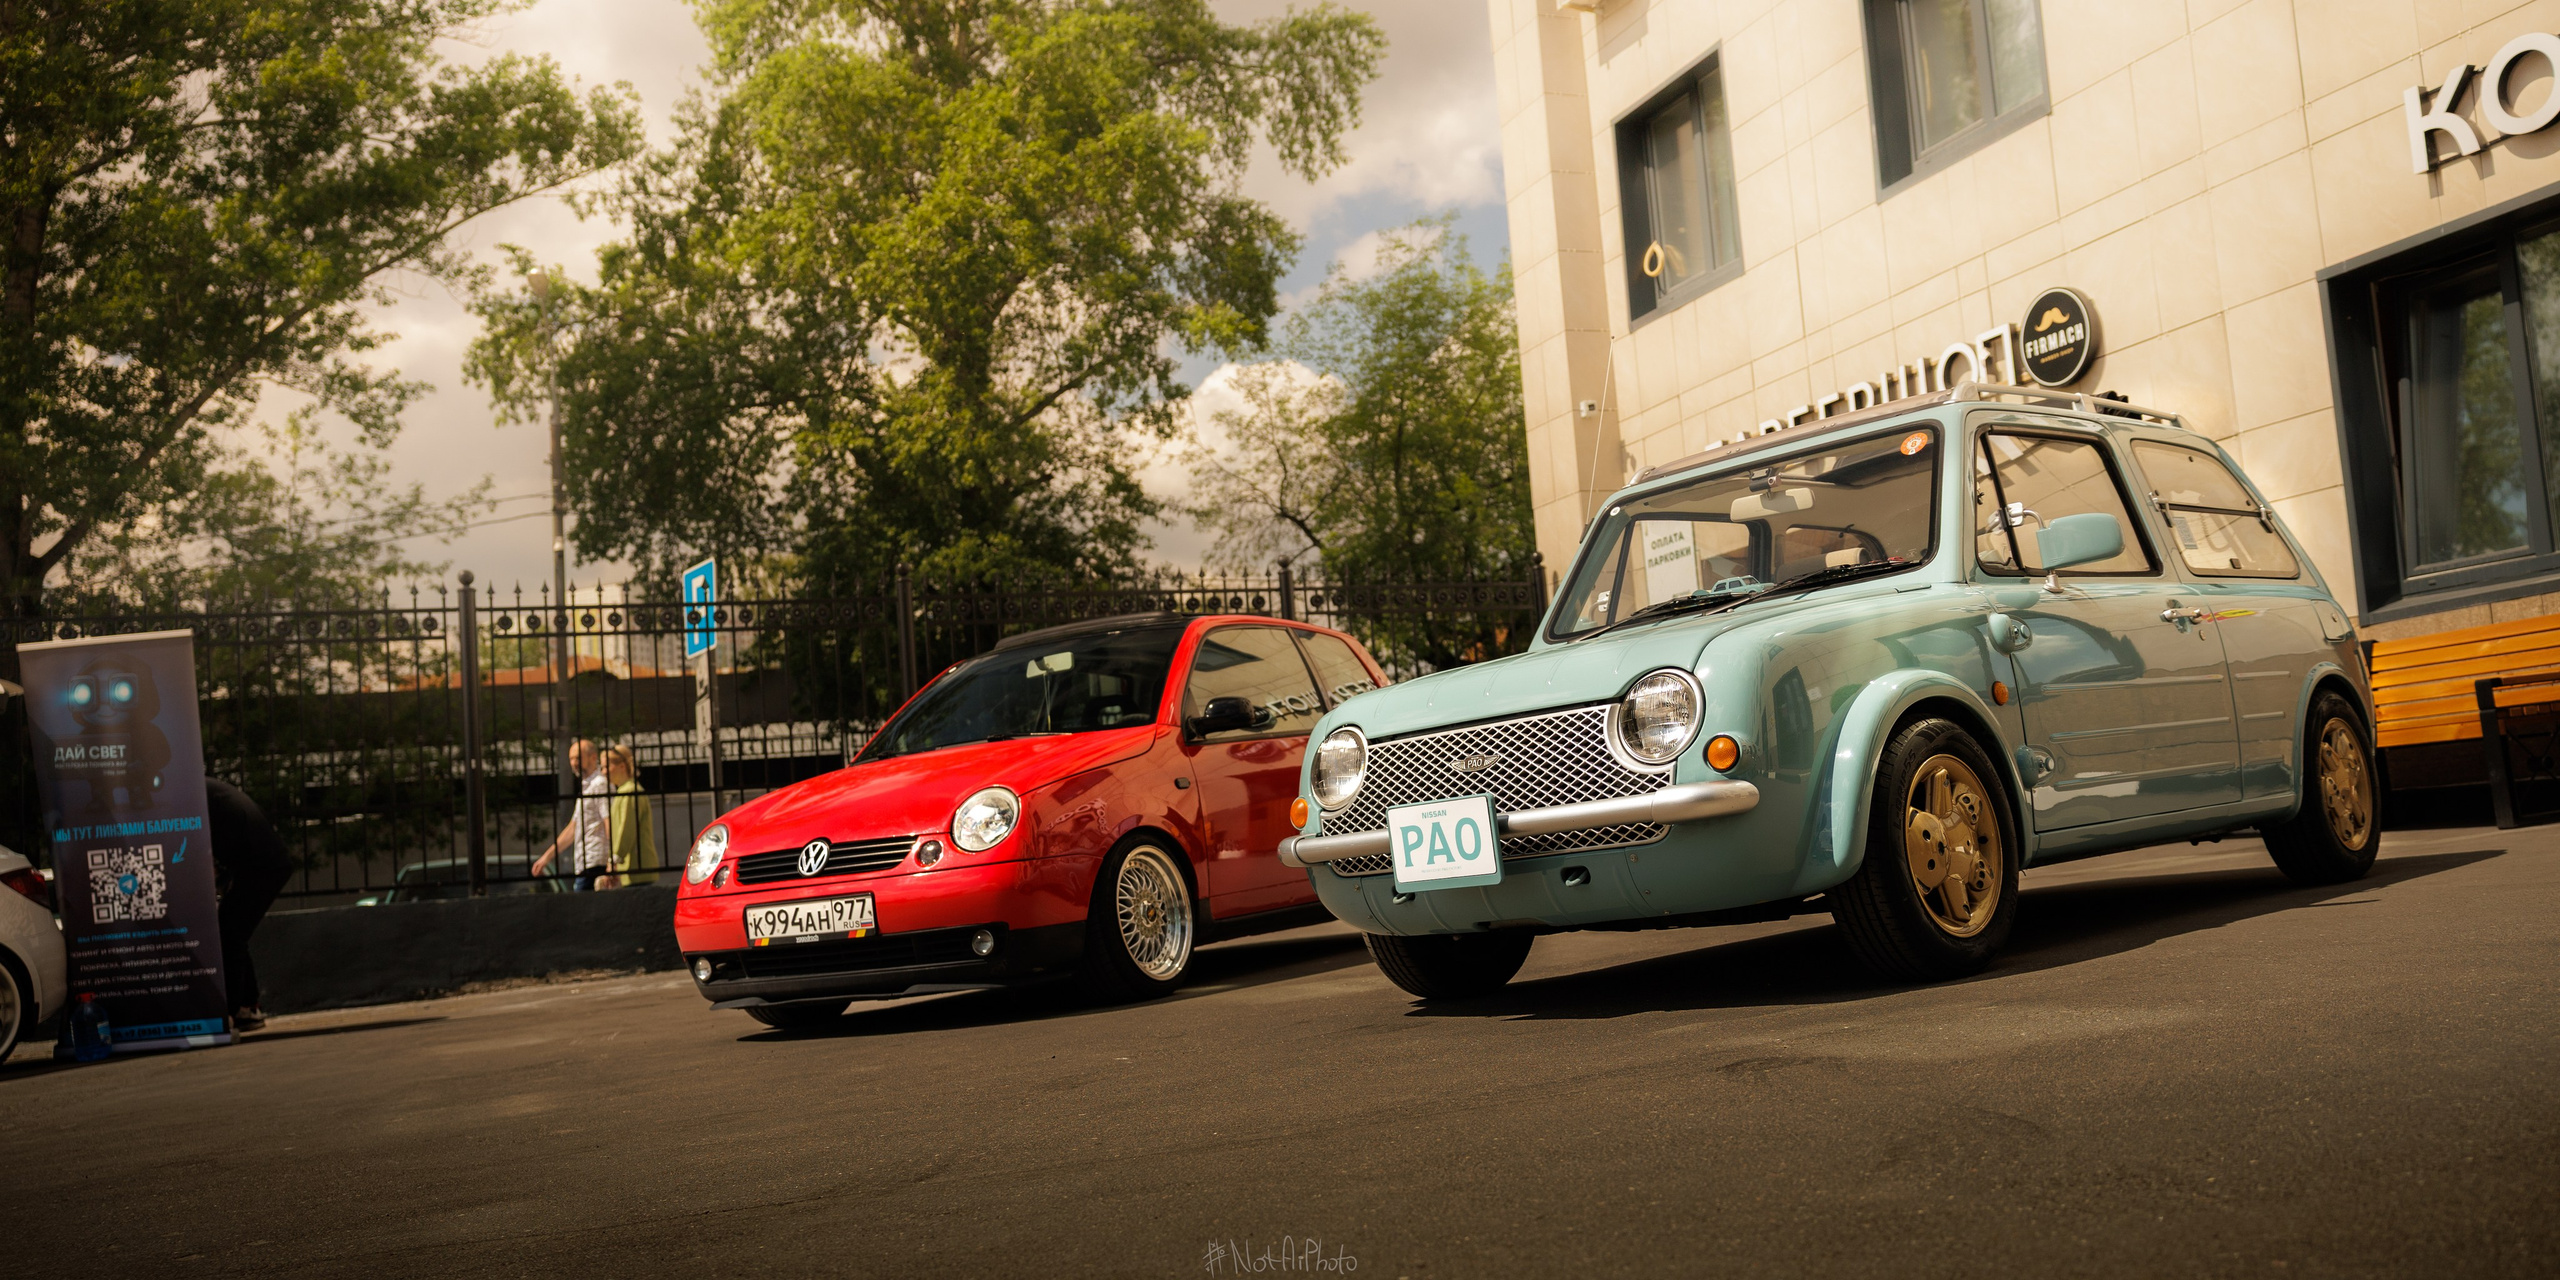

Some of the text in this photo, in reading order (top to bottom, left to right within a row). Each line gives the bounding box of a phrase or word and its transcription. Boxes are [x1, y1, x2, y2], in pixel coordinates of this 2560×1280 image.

[2025, 322, 2085, 360] FIRMACH
[1650, 531, 1685, 550] ОПЛАТА
[1647, 546, 1692, 569] ПАРКОВКИ
[54, 743, 127, 762] ДАЙ СВЕТ
[1467, 758, 1483, 769] PAO
[1421, 809, 1447, 819] NISSAN
[72, 826, 93, 841] ТУТ
[94, 820, 146, 839] ЛИНЗАМИ
[147, 816, 202, 834] БАЛУЕМСЯ
[1399, 817, 1482, 868] PAO
[798, 841, 829, 876] VW
[834, 898, 867, 921] 977
[843, 920, 860, 929] RUS
